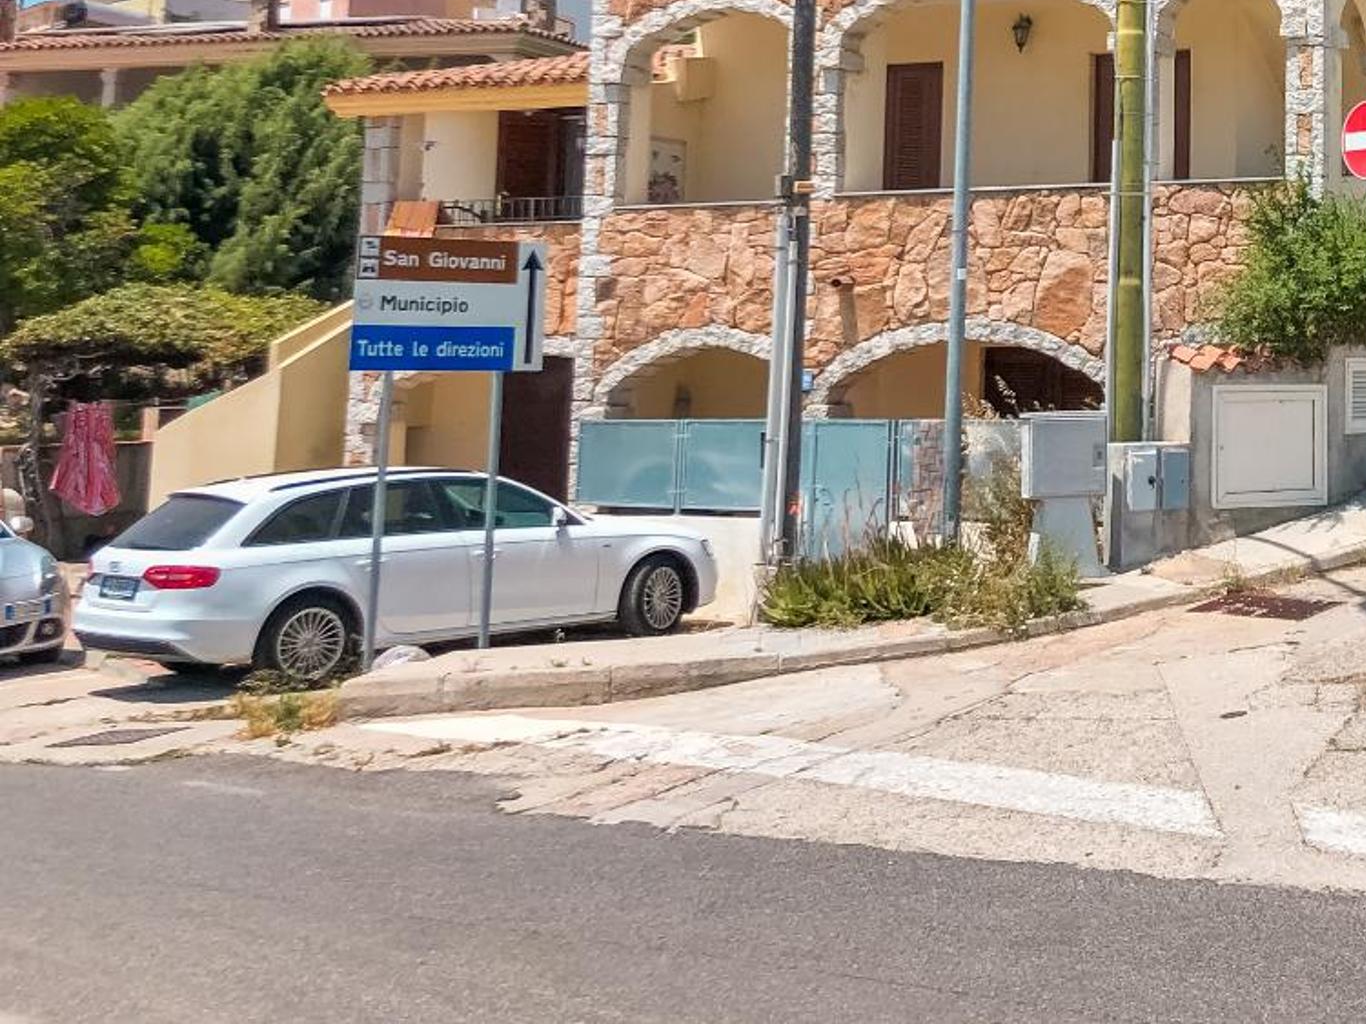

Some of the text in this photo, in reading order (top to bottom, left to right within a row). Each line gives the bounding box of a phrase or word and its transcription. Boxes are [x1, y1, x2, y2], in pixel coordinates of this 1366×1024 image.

[383, 250, 506, 270] San Giovanni
[379, 295, 469, 315] Municipio
[357, 340, 504, 357] Tutte le direzioni
